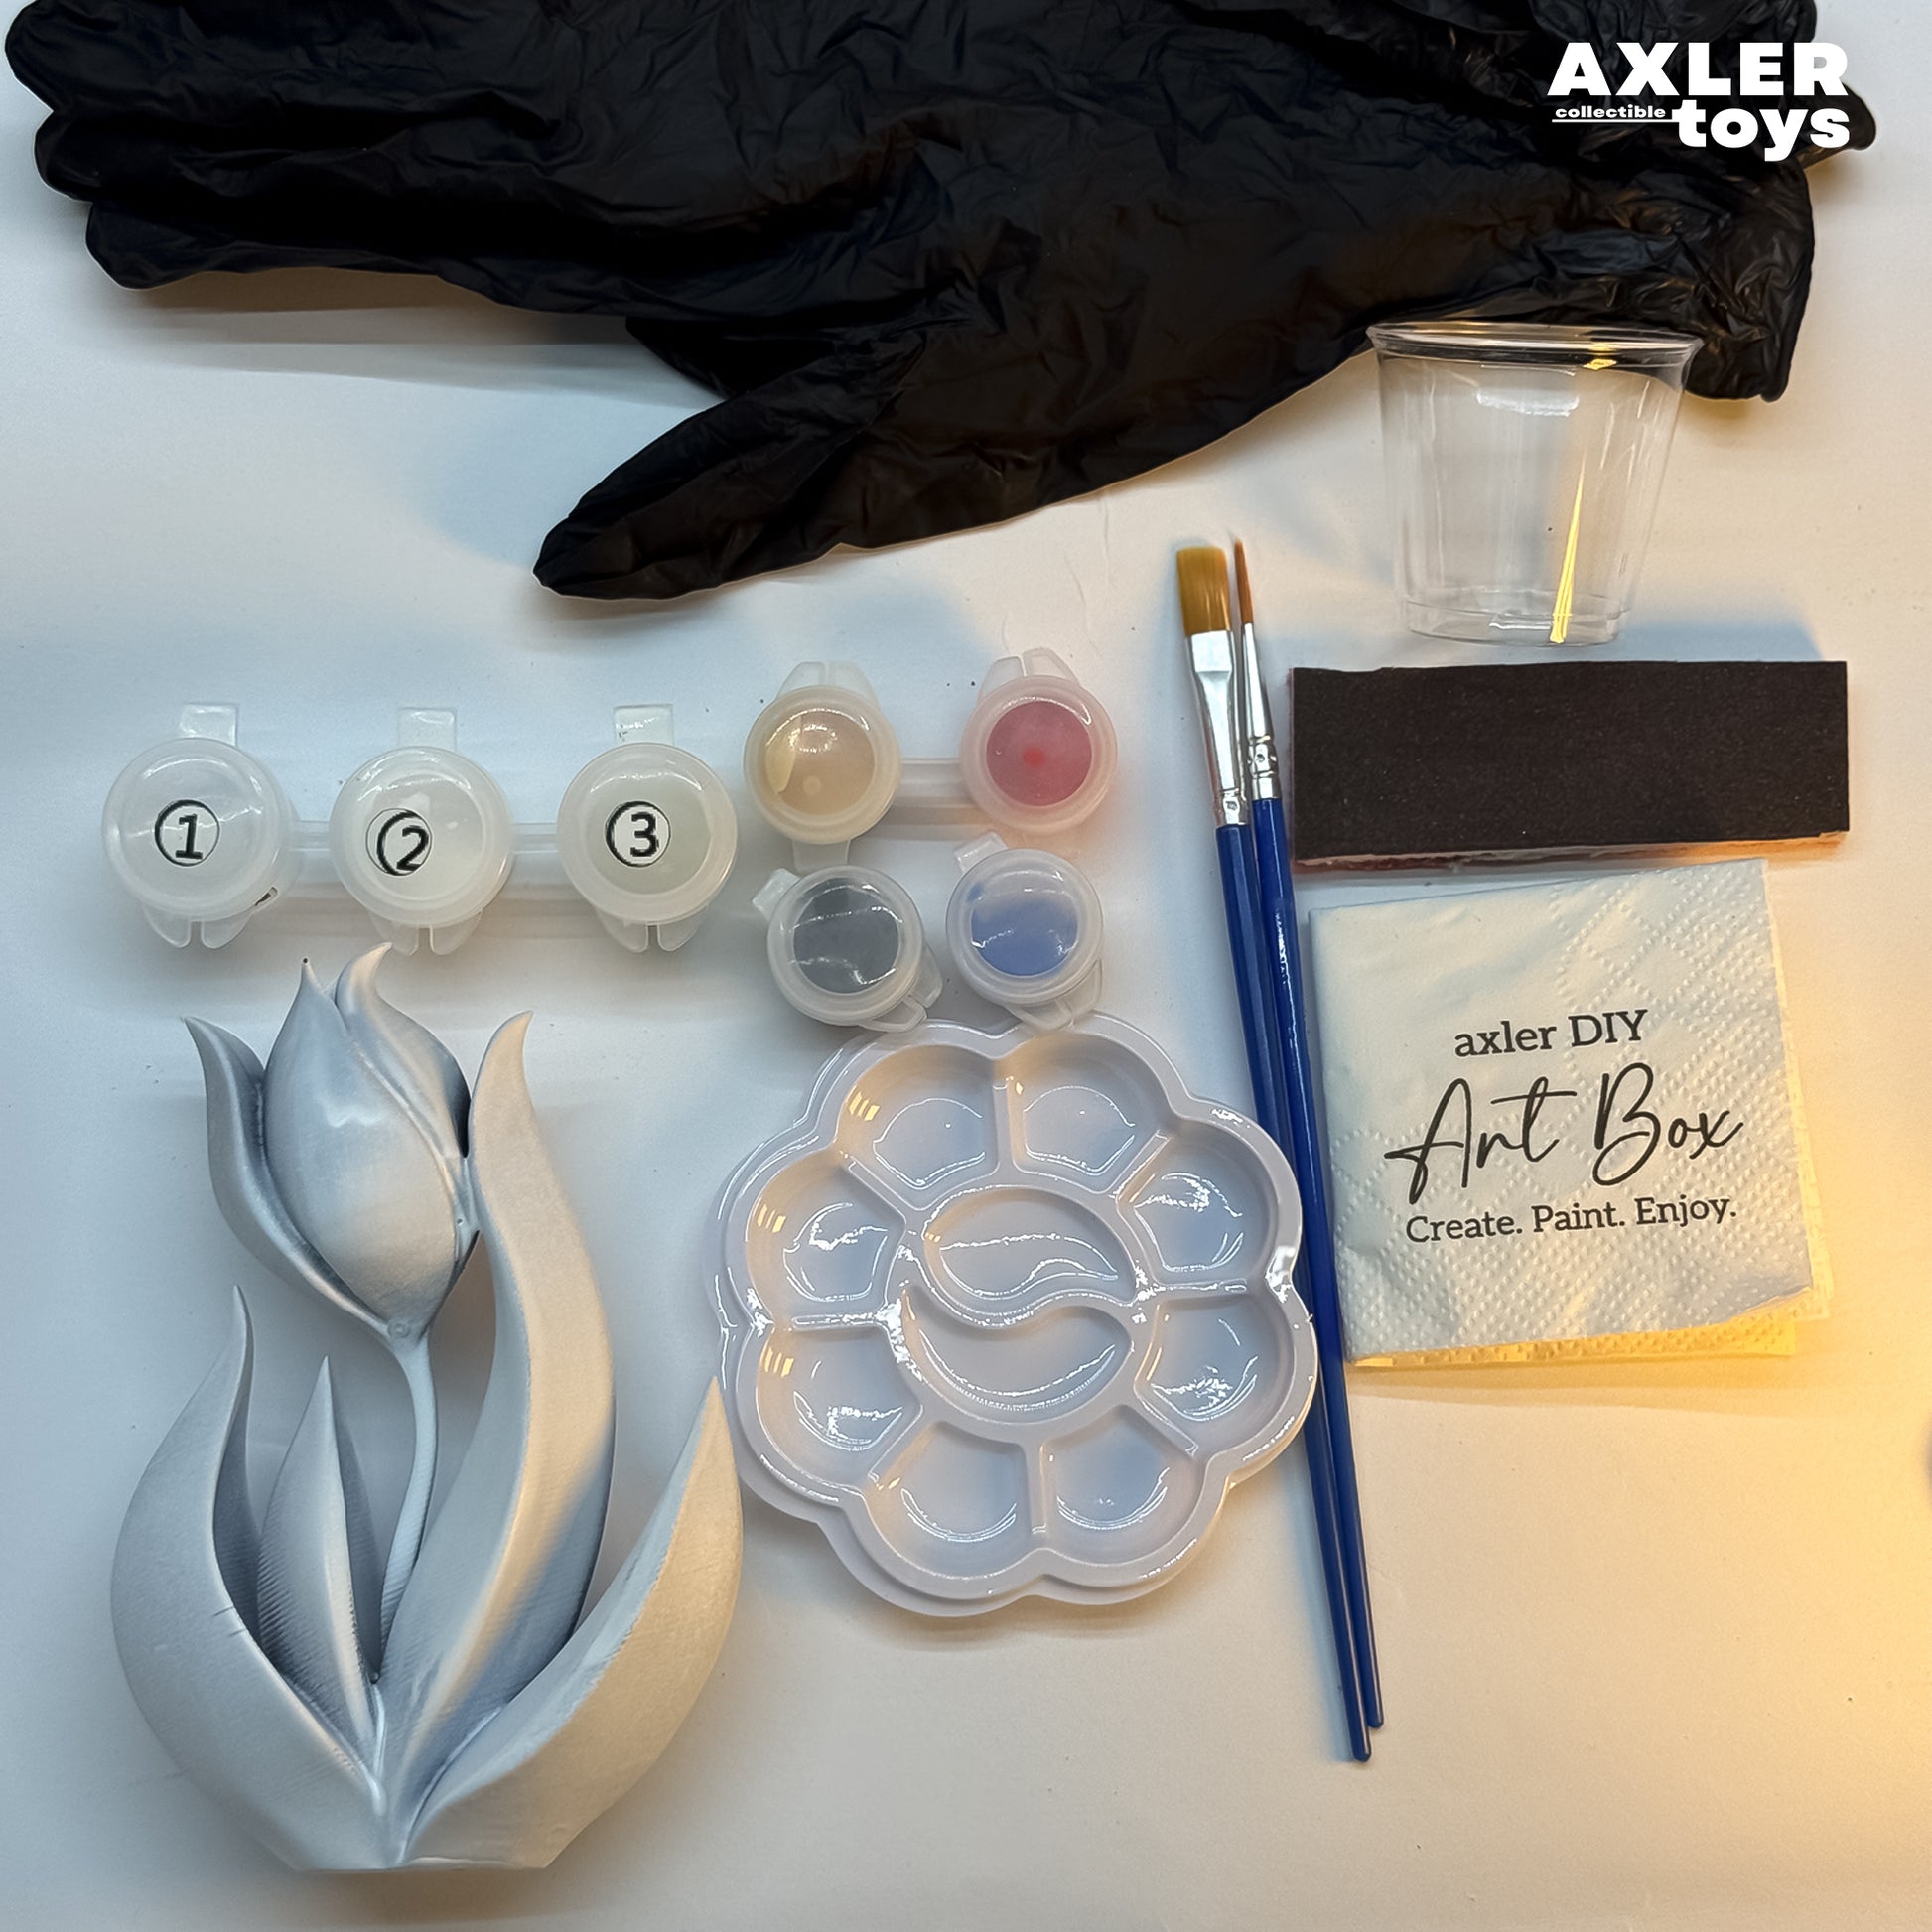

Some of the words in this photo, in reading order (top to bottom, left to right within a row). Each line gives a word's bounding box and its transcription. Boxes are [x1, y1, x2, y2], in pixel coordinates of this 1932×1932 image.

[1454, 1021, 1557, 1057] axler
[1568, 1009, 1648, 1047] DIY
[1384, 1076, 1577, 1205] Art
[1592, 1062, 1744, 1186] Box
[1405, 1211, 1523, 1243] Create.
[1531, 1202, 1625, 1233] Paint.
[1634, 1194, 1737, 1228] Enjoy.
